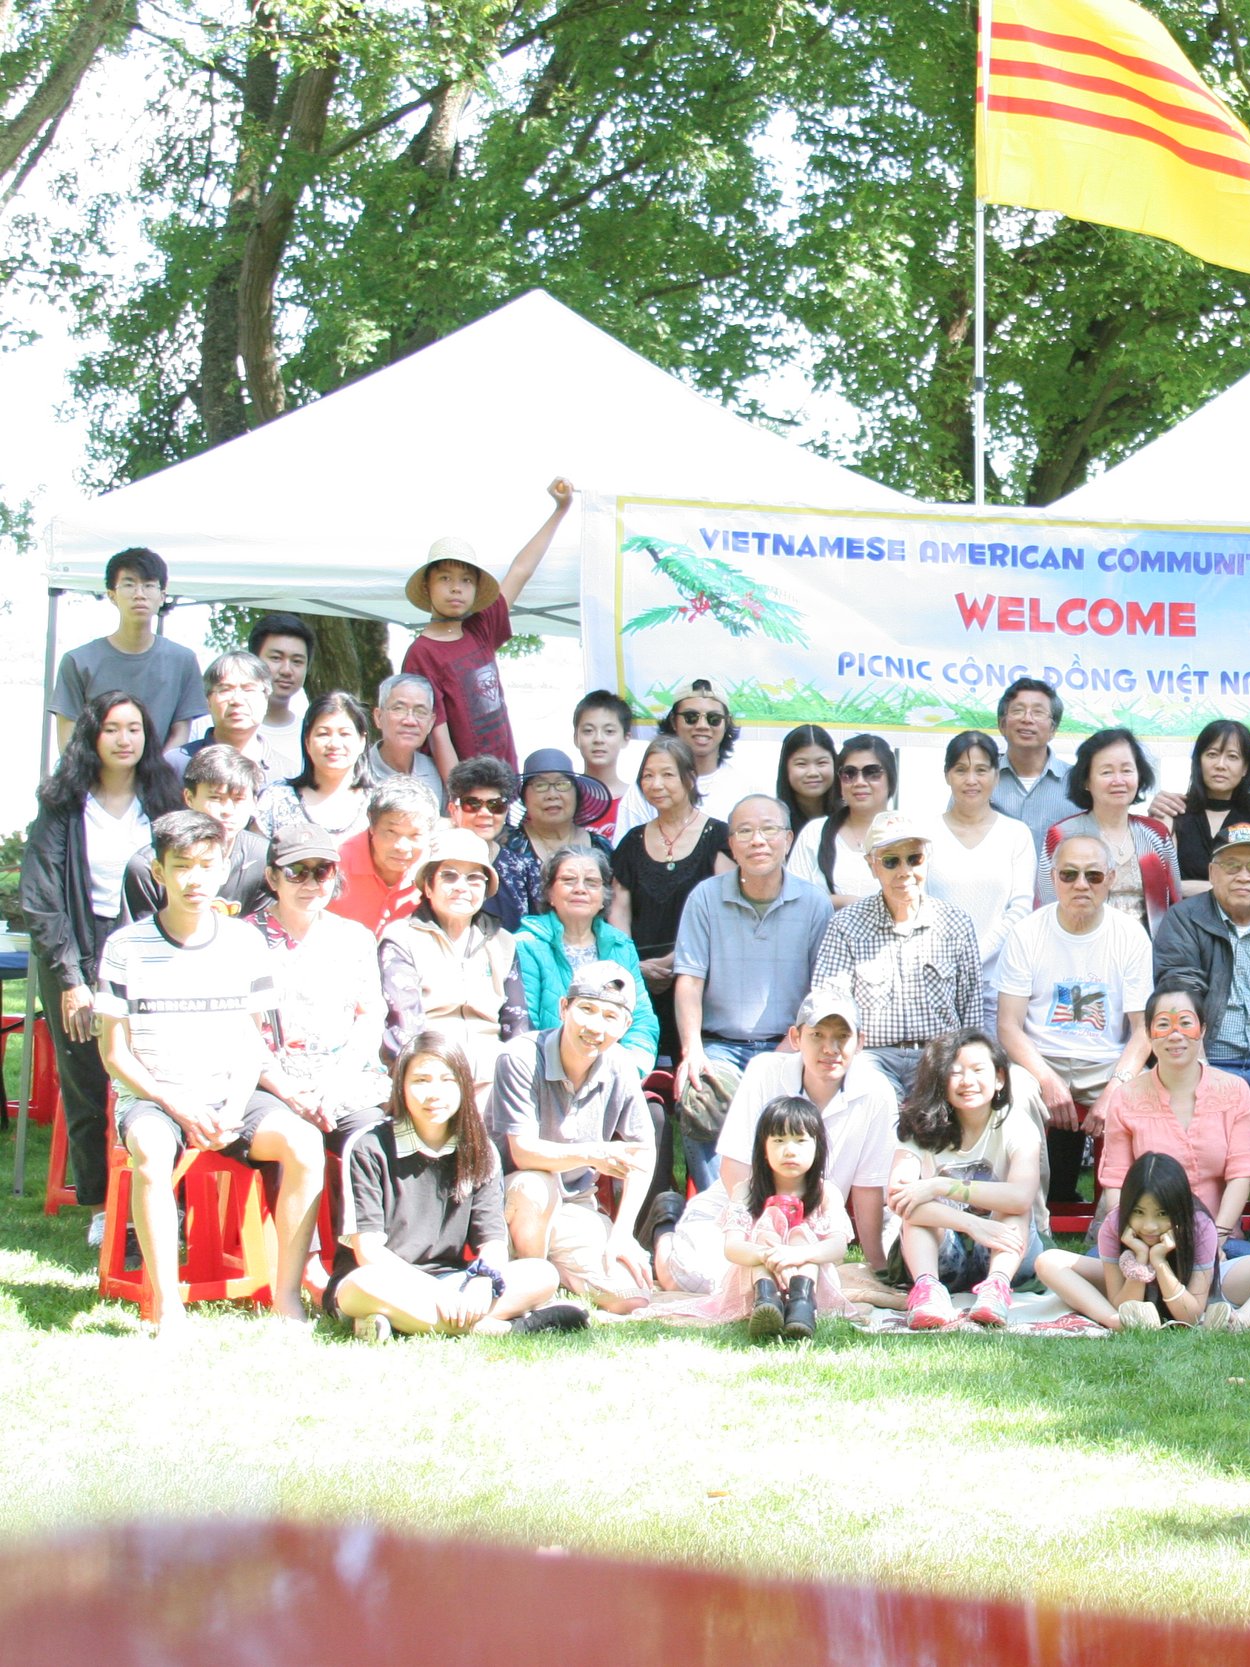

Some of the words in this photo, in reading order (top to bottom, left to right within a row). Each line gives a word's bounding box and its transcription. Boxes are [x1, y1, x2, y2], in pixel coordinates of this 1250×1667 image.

[699, 527, 906, 562] VIETNAMESE
[919, 540, 1085, 570] AMERICAN
[954, 592, 1197, 637] WELCOME
[838, 651, 933, 682] PICNIC
[1147, 663, 1209, 703] VIỆT
[139, 998, 207, 1012] AMERICAN
